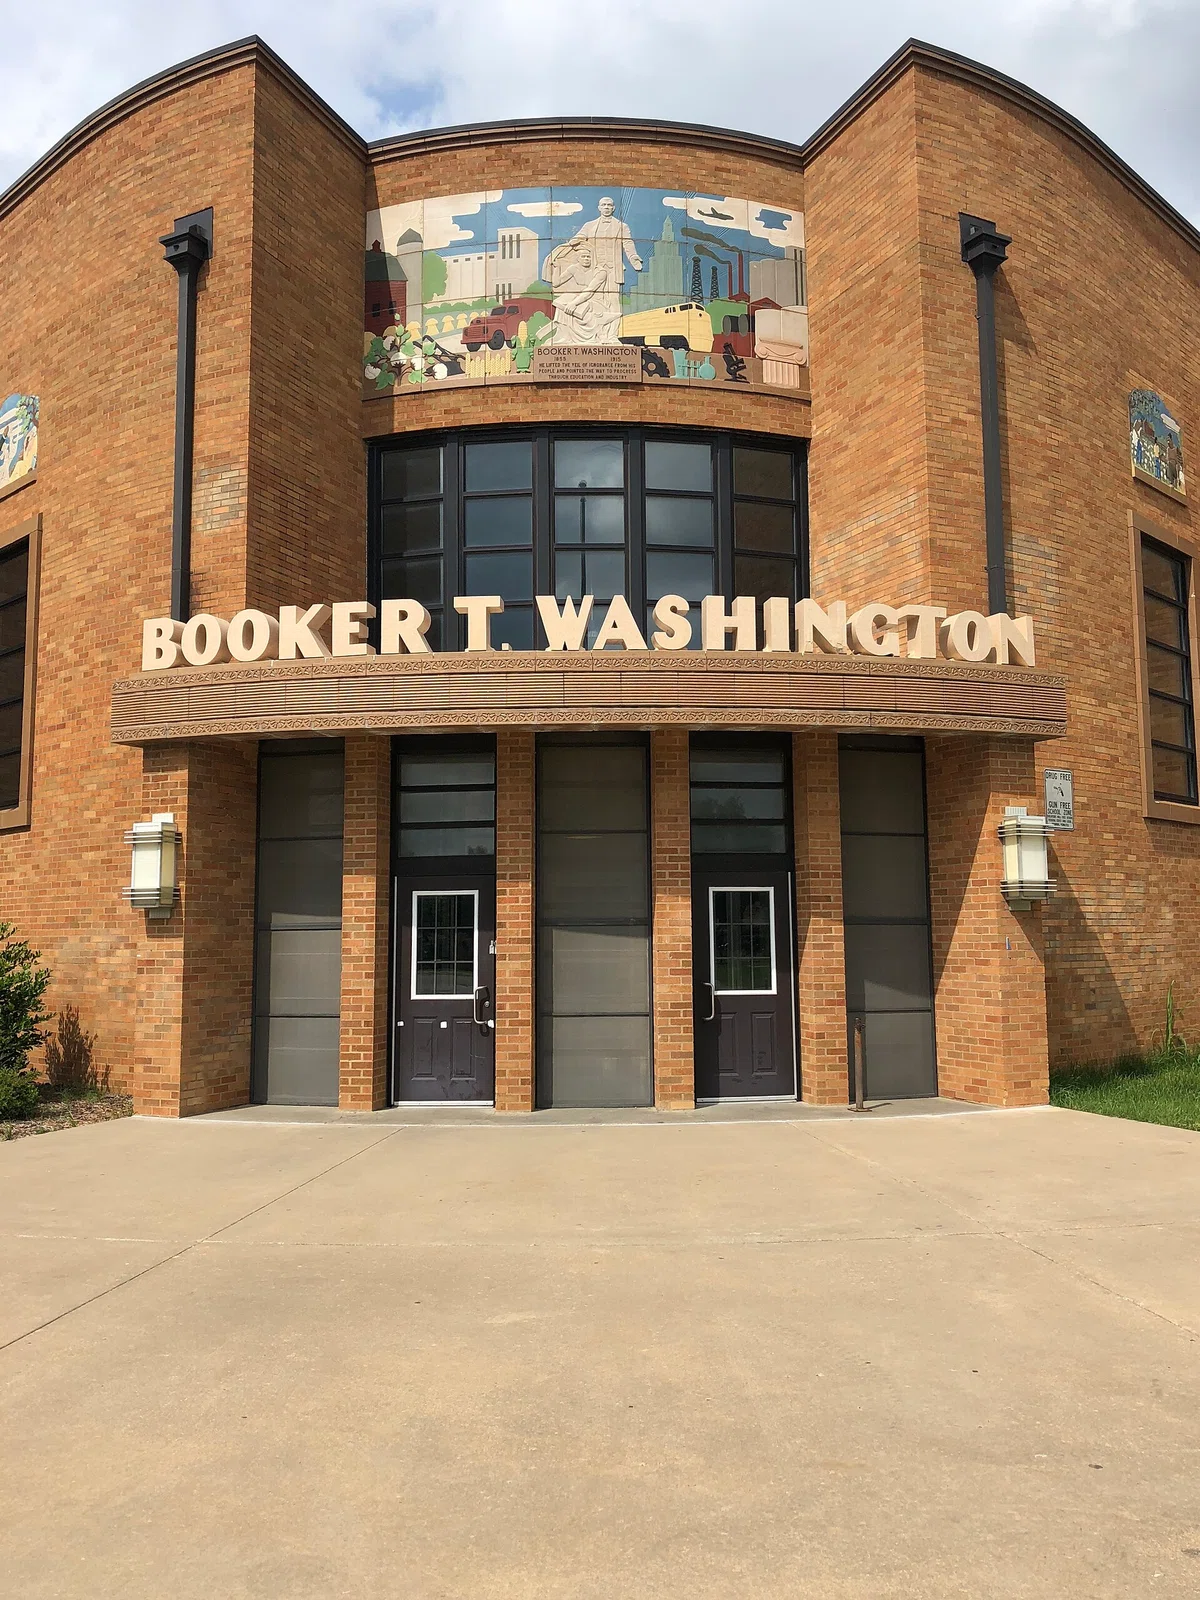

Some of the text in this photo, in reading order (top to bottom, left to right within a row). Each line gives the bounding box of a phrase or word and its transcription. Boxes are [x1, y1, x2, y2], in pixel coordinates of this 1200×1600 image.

[537, 347, 638, 356] BOOKER T. WASHINGTON
[142, 594, 1036, 671] BOOKER T. WASHINGTON
[1045, 772, 1071, 781] DRUG FREE
[1060, 802, 1071, 810] FREE
